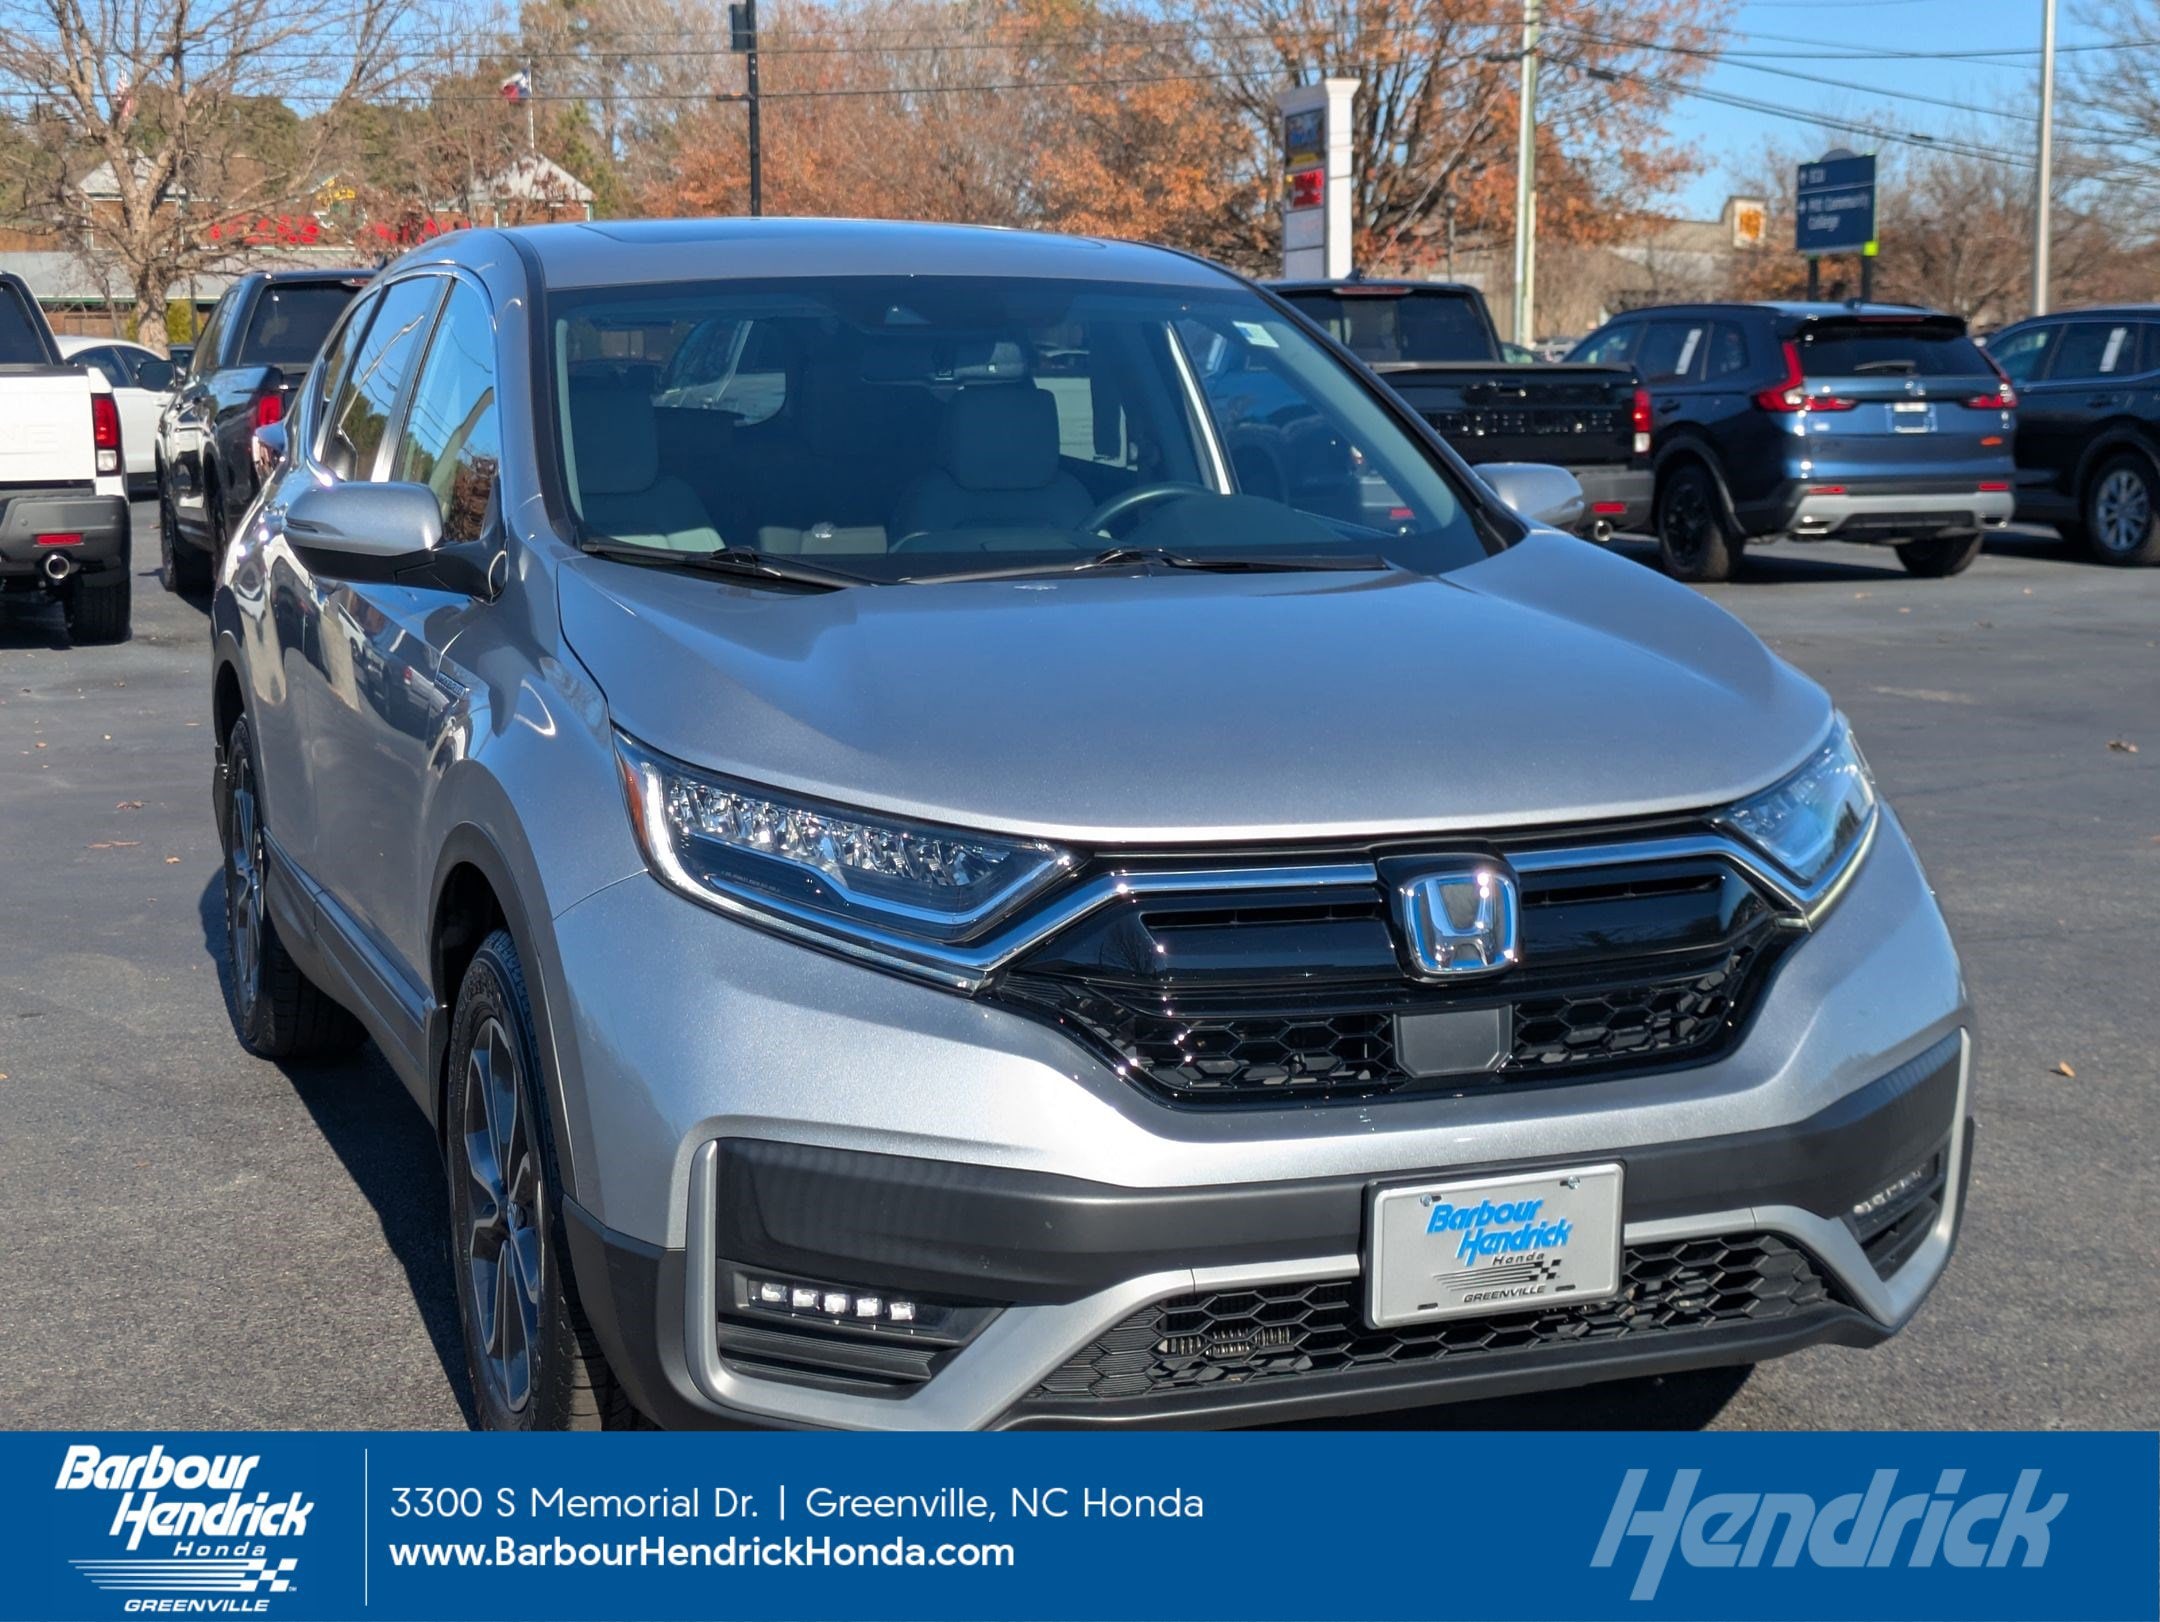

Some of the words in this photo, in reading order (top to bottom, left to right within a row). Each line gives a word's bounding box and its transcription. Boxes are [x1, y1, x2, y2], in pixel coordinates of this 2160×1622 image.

[1425, 1199, 1545, 1235] Barbour
[1455, 1216, 1573, 1267] Hendrick
[1492, 1252, 1545, 1266] Honda
[1464, 1284, 1546, 1303] GREENVILLE
